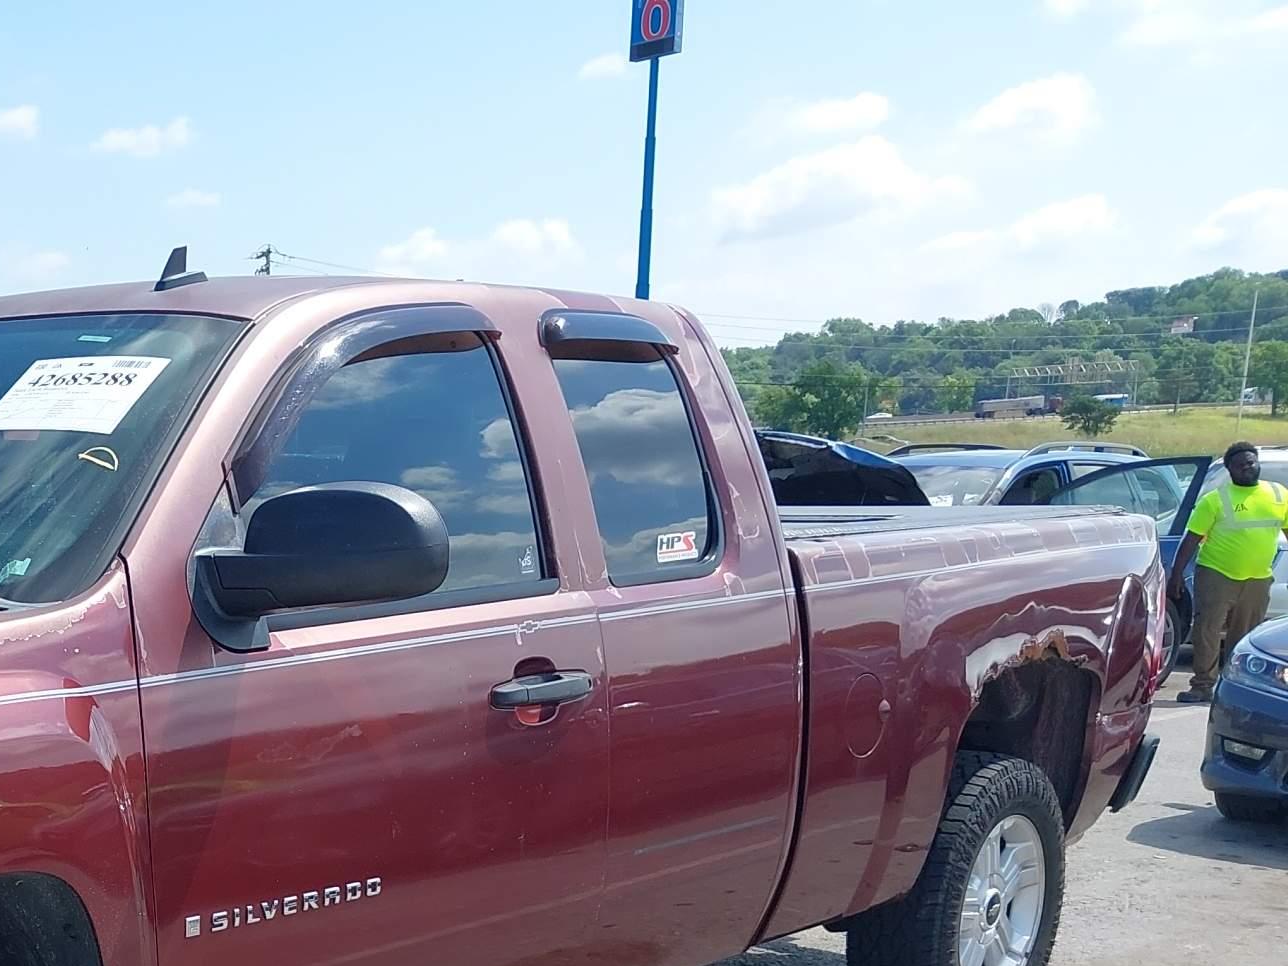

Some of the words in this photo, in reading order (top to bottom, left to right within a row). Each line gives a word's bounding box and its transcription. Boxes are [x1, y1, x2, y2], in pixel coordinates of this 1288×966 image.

[28, 373, 137, 387] 42685288
[659, 533, 696, 552] HPS
[211, 877, 383, 932] SILVERADO
